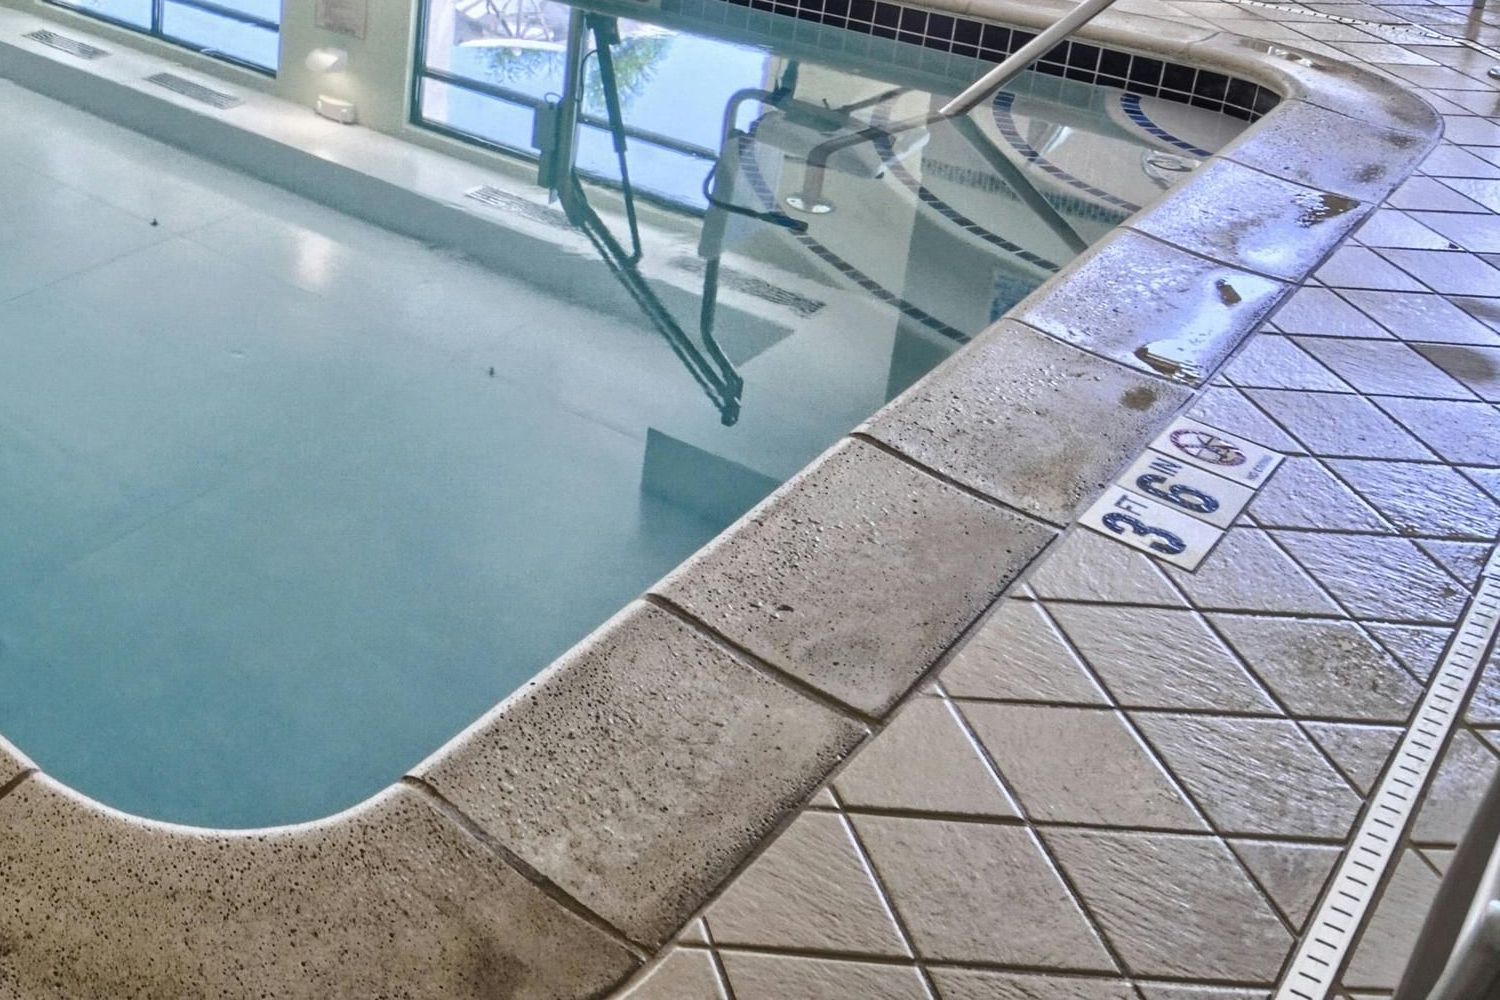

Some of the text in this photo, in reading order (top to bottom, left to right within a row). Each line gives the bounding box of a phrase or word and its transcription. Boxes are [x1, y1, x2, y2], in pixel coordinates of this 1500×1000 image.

[1101, 457, 1220, 555] 3 FT 6 IN
